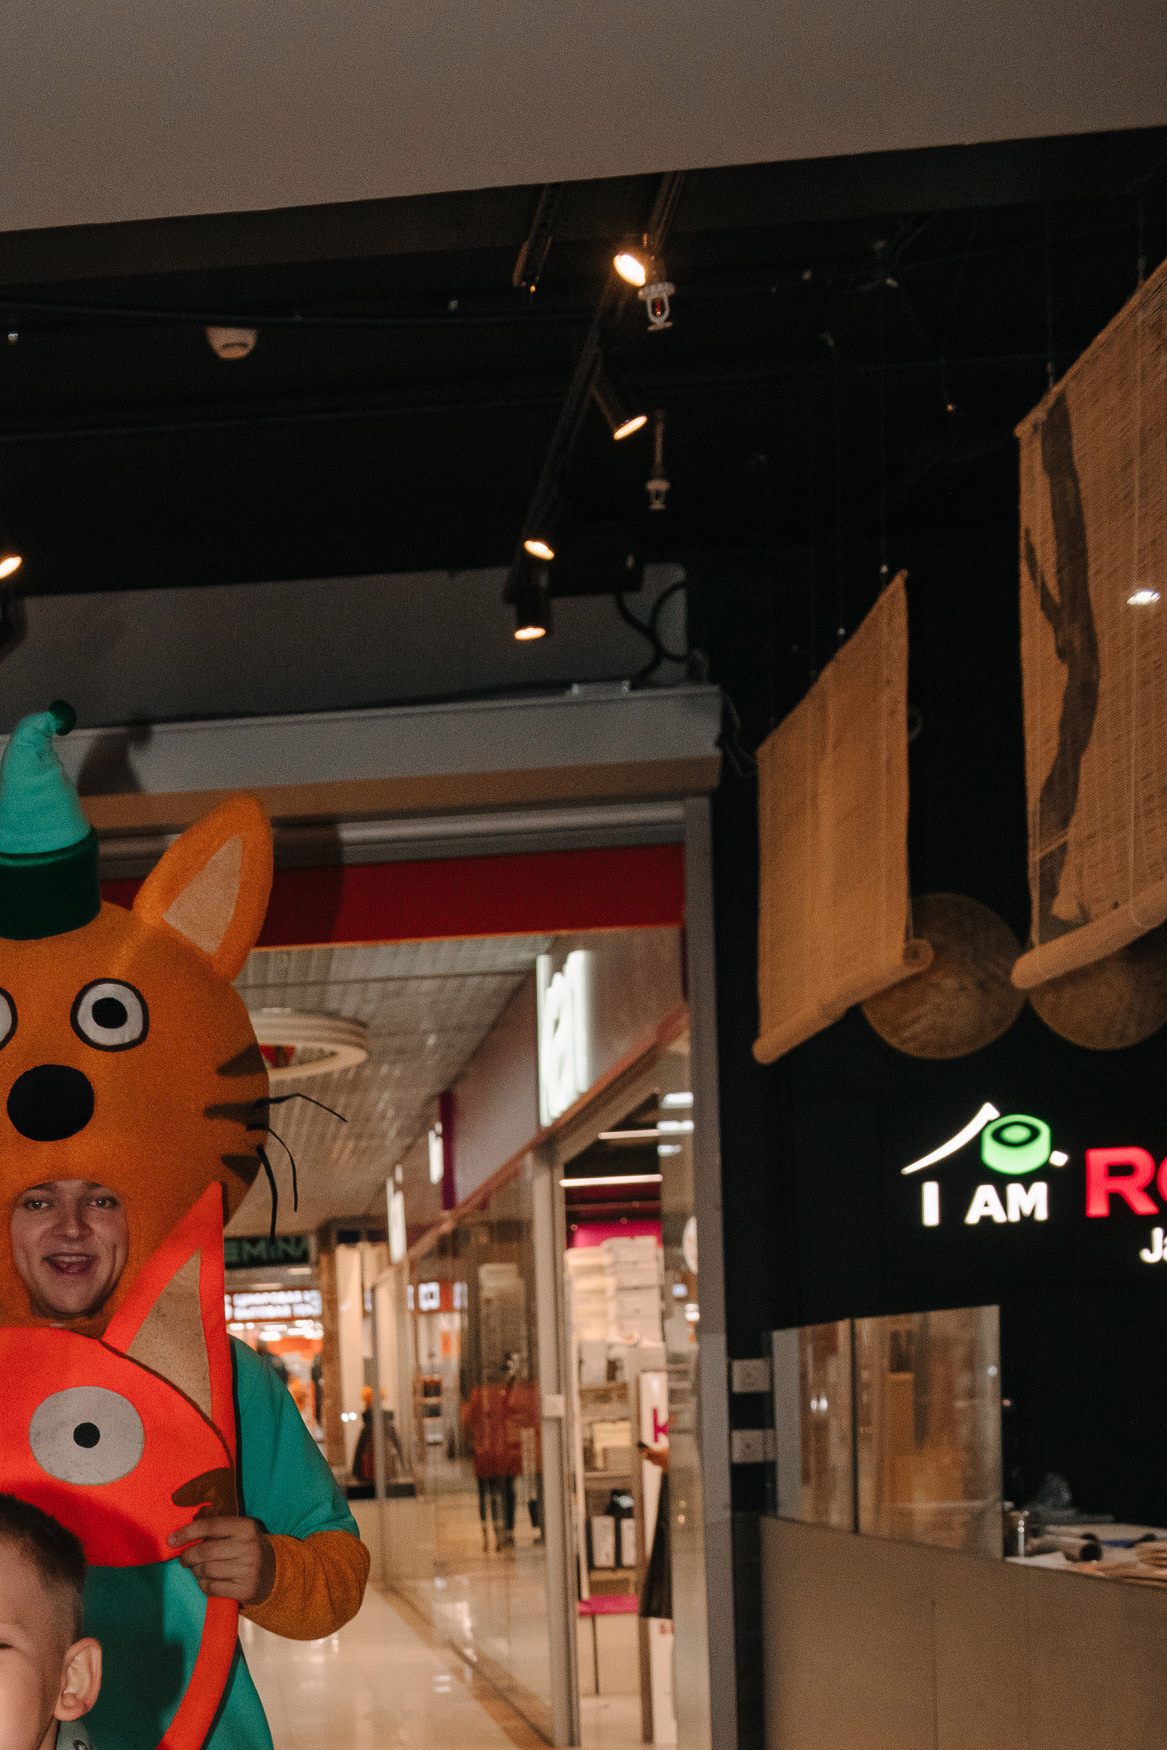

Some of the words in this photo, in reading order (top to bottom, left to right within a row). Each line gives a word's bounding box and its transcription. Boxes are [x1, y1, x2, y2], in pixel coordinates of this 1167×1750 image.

[921, 1181, 941, 1228] I
[964, 1181, 1049, 1225] AM
[1084, 1146, 1167, 1219] R
[1139, 1226, 1167, 1264] J
